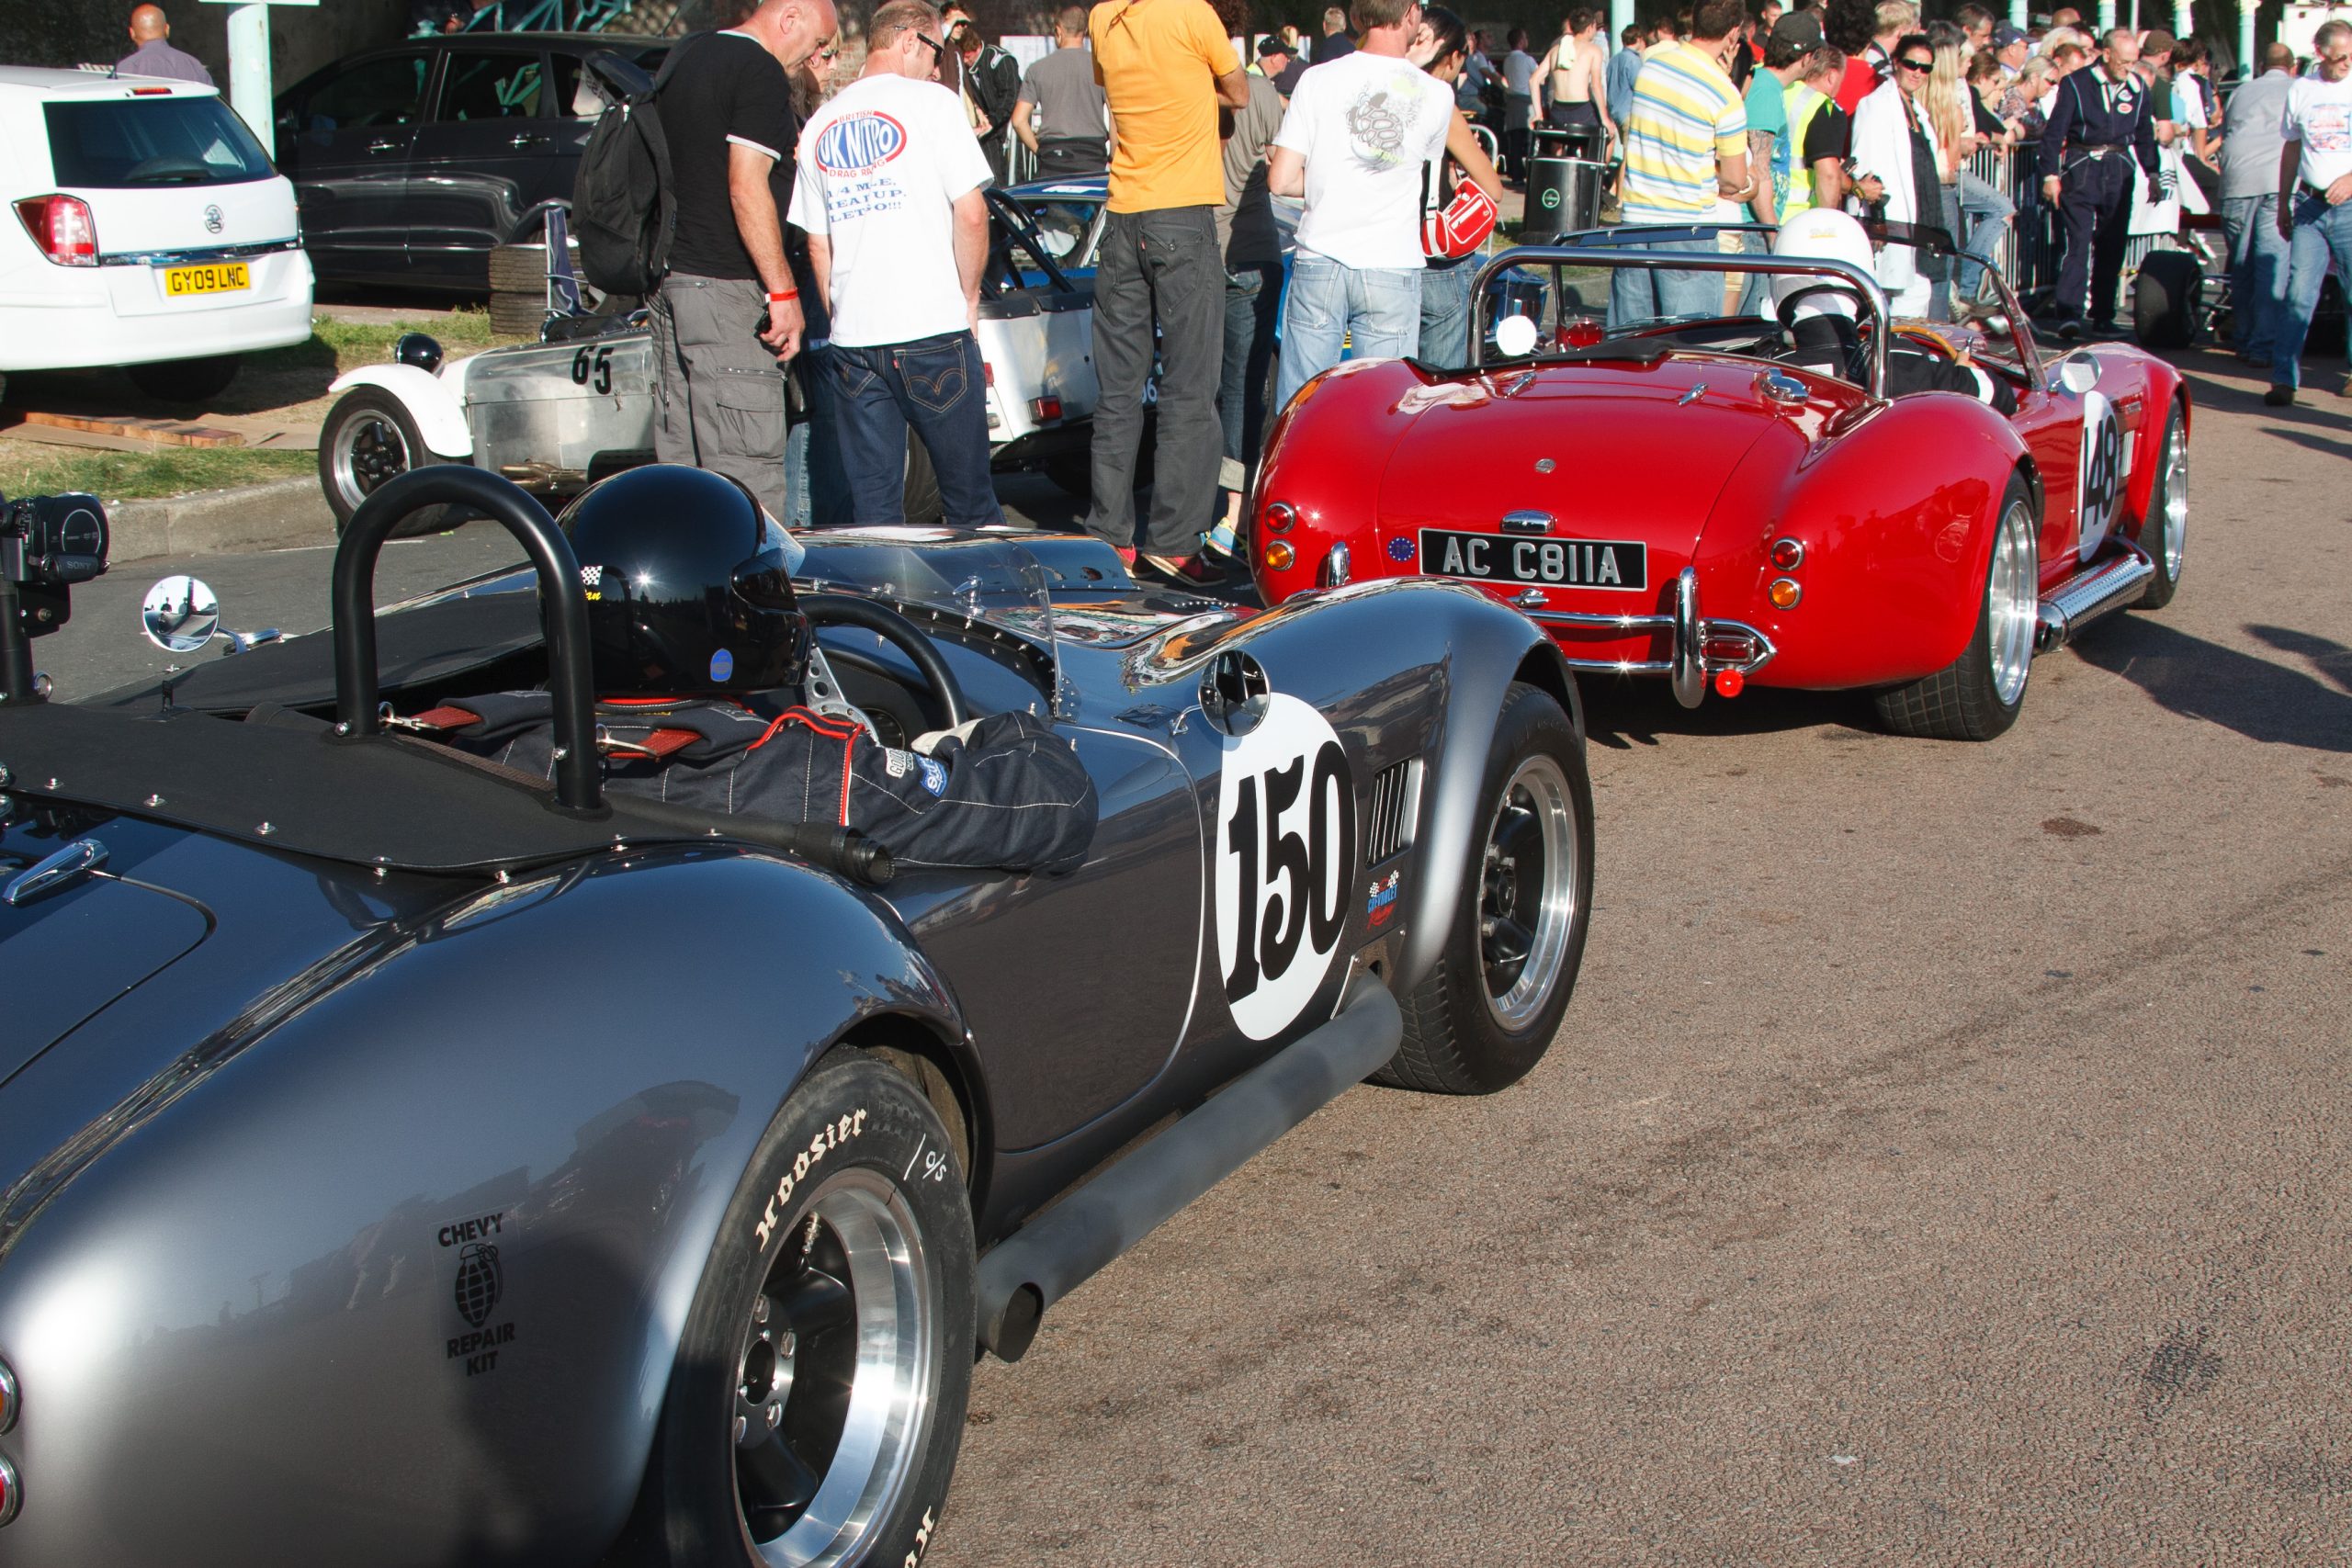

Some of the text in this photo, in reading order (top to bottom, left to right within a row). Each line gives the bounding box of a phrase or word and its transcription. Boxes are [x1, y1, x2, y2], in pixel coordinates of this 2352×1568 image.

[839, 109, 873, 123] BRITISH
[818, 124, 848, 168] UK
[829, 169, 857, 178] DRAG
[171, 266, 244, 292] GY09 LNC
[572, 345, 615, 395] 65
[2080, 414, 2118, 535] 148
[66, 560, 92, 570] SONY
[1442, 536, 1622, 584] AC C811A
[1226, 740, 1356, 1005] 150
[1367, 884, 1397, 914] CHEVROLET
[755, 1108, 867, 1253] Hoosier
[438, 1213, 503, 1247] CHEVY
[447, 1322, 515, 1359] REPAIR
[467, 1350, 499, 1376] KIT
